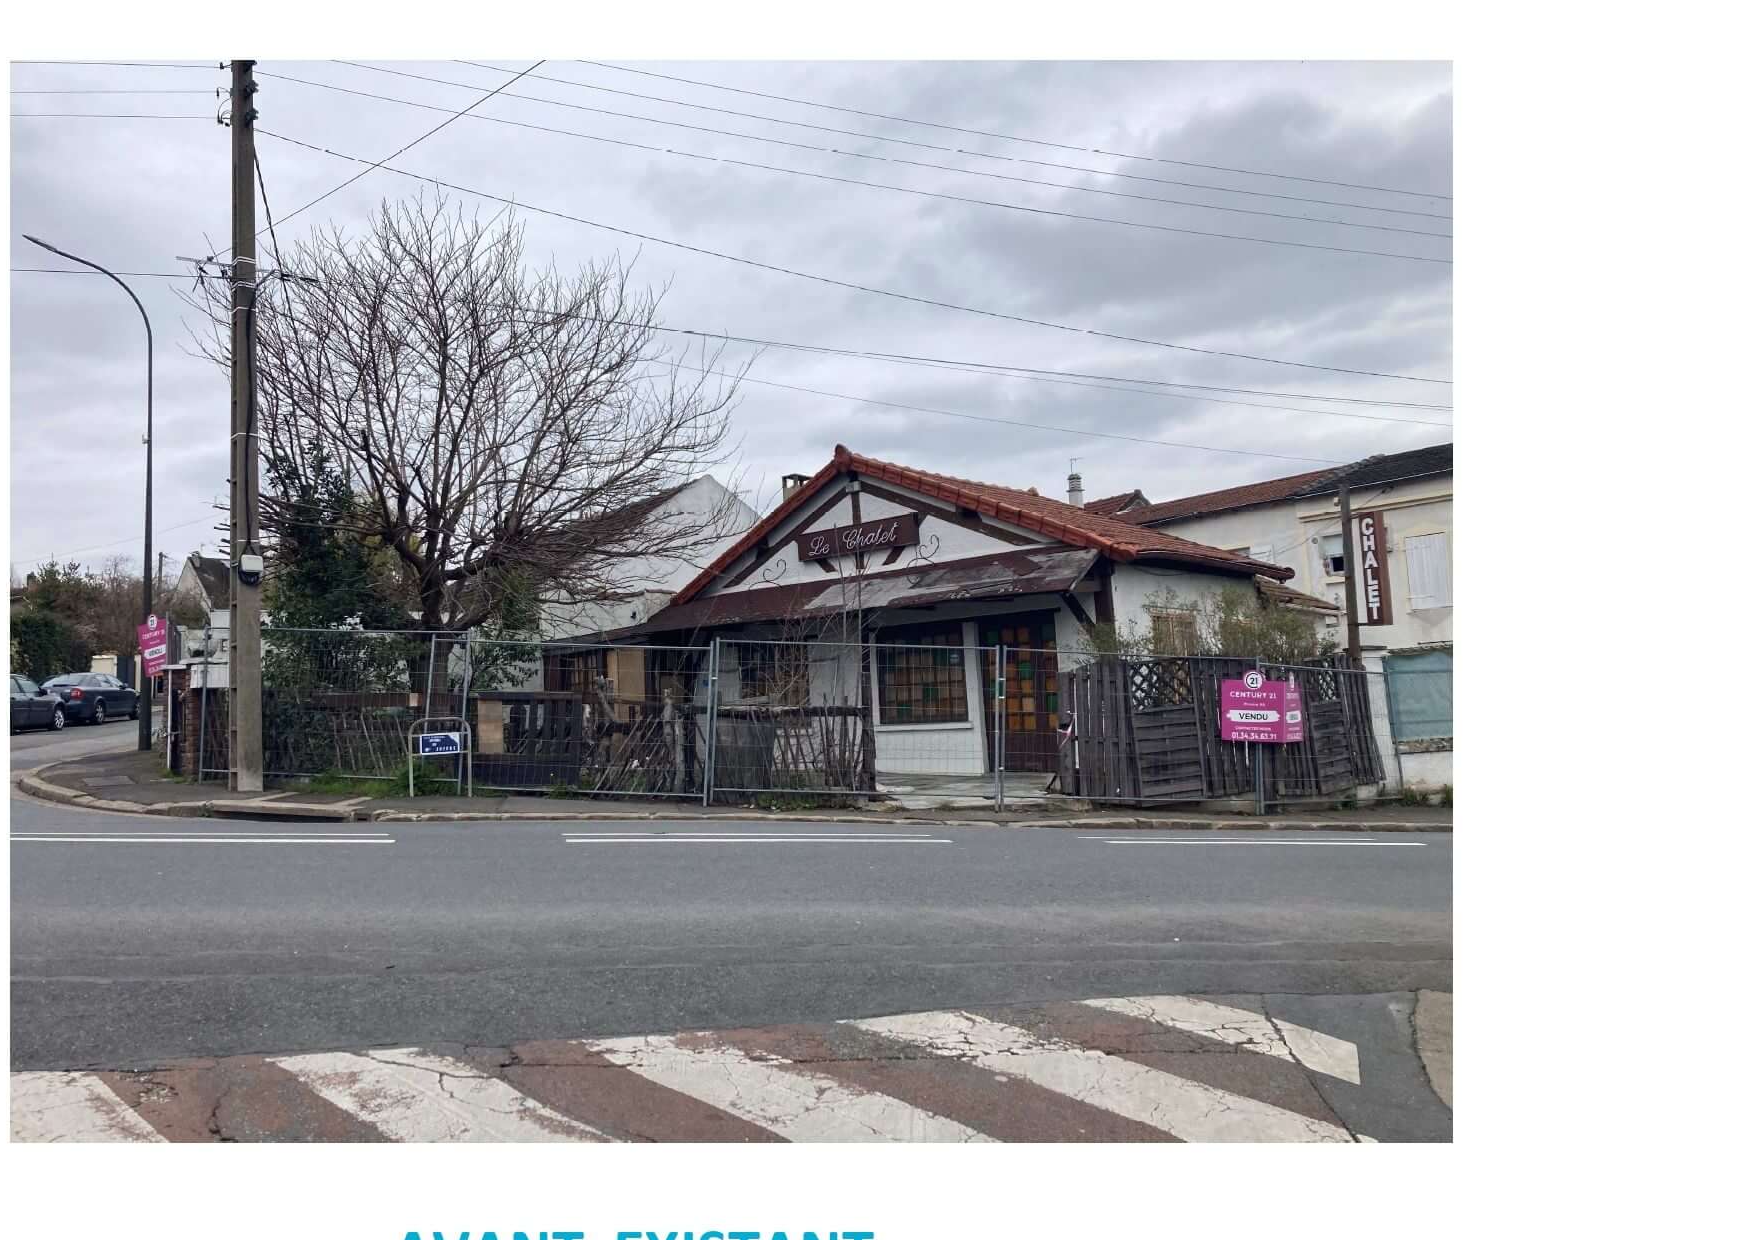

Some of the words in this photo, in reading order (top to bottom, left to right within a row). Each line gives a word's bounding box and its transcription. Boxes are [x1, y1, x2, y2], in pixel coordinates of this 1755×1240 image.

[808, 536, 830, 555] Le
[842, 521, 900, 549] Chalet
[1361, 517, 1380, 620] CHALET
[1249, 677, 1258, 685] 21
